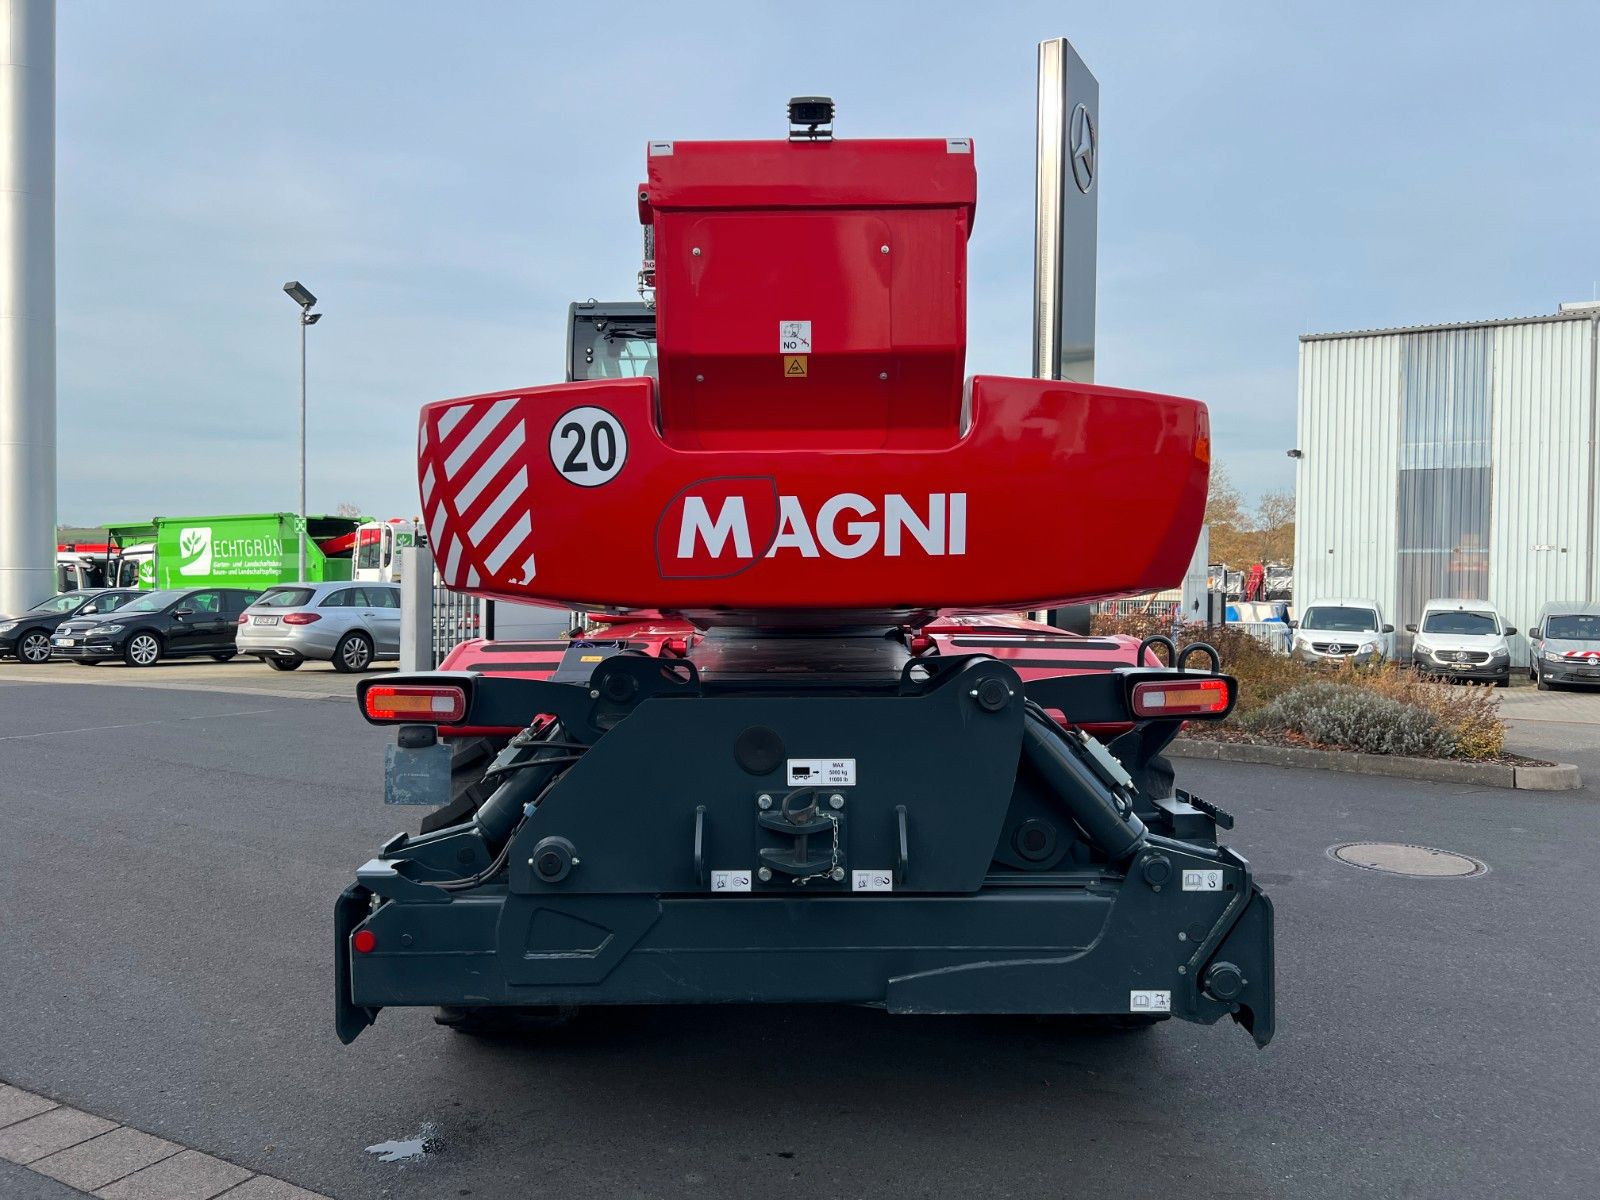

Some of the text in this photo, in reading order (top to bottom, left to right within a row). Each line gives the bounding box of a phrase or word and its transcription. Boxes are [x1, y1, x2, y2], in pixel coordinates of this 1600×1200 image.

[783, 341, 797, 350] NO
[560, 420, 617, 473] 20
[676, 492, 967, 560] MAGNI
[213, 535, 283, 557] ECHTGRÜN
